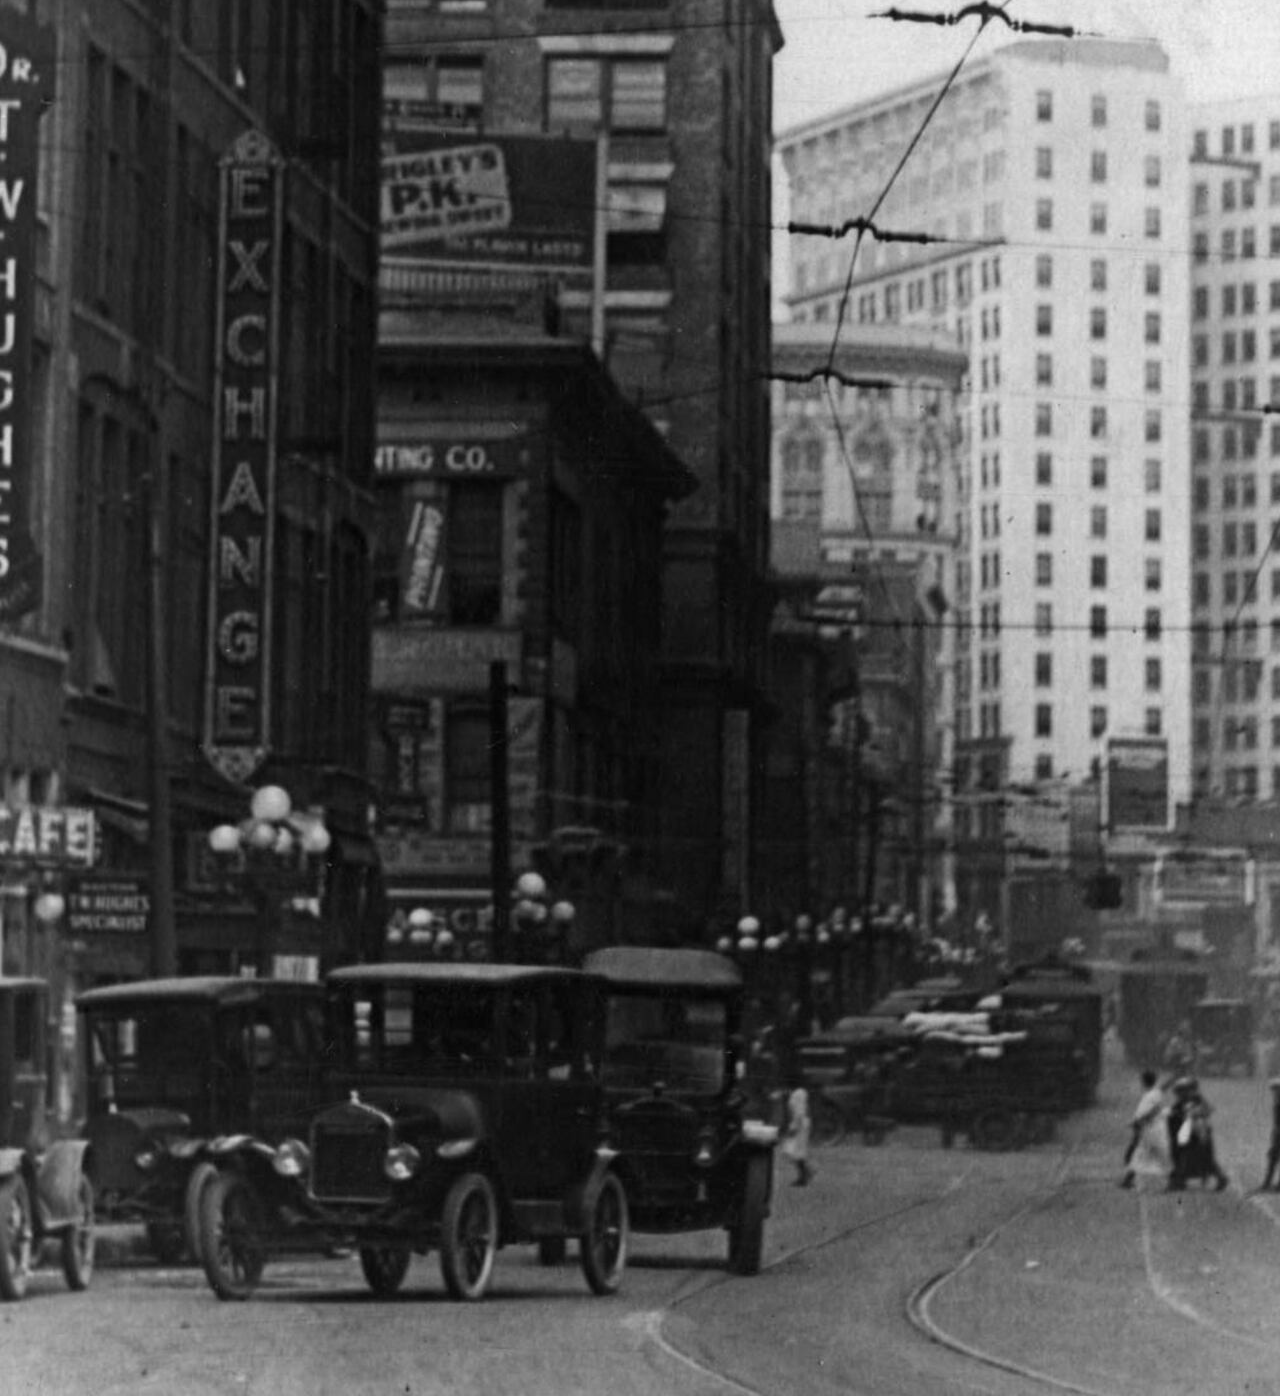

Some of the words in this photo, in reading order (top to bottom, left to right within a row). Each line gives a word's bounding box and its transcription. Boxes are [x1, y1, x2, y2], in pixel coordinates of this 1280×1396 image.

[381, 151, 498, 181] RIGLEY'S
[390, 179, 477, 215] P.K.
[217, 168, 270, 739] EXCHANGE
[446, 445, 496, 472] CO.
